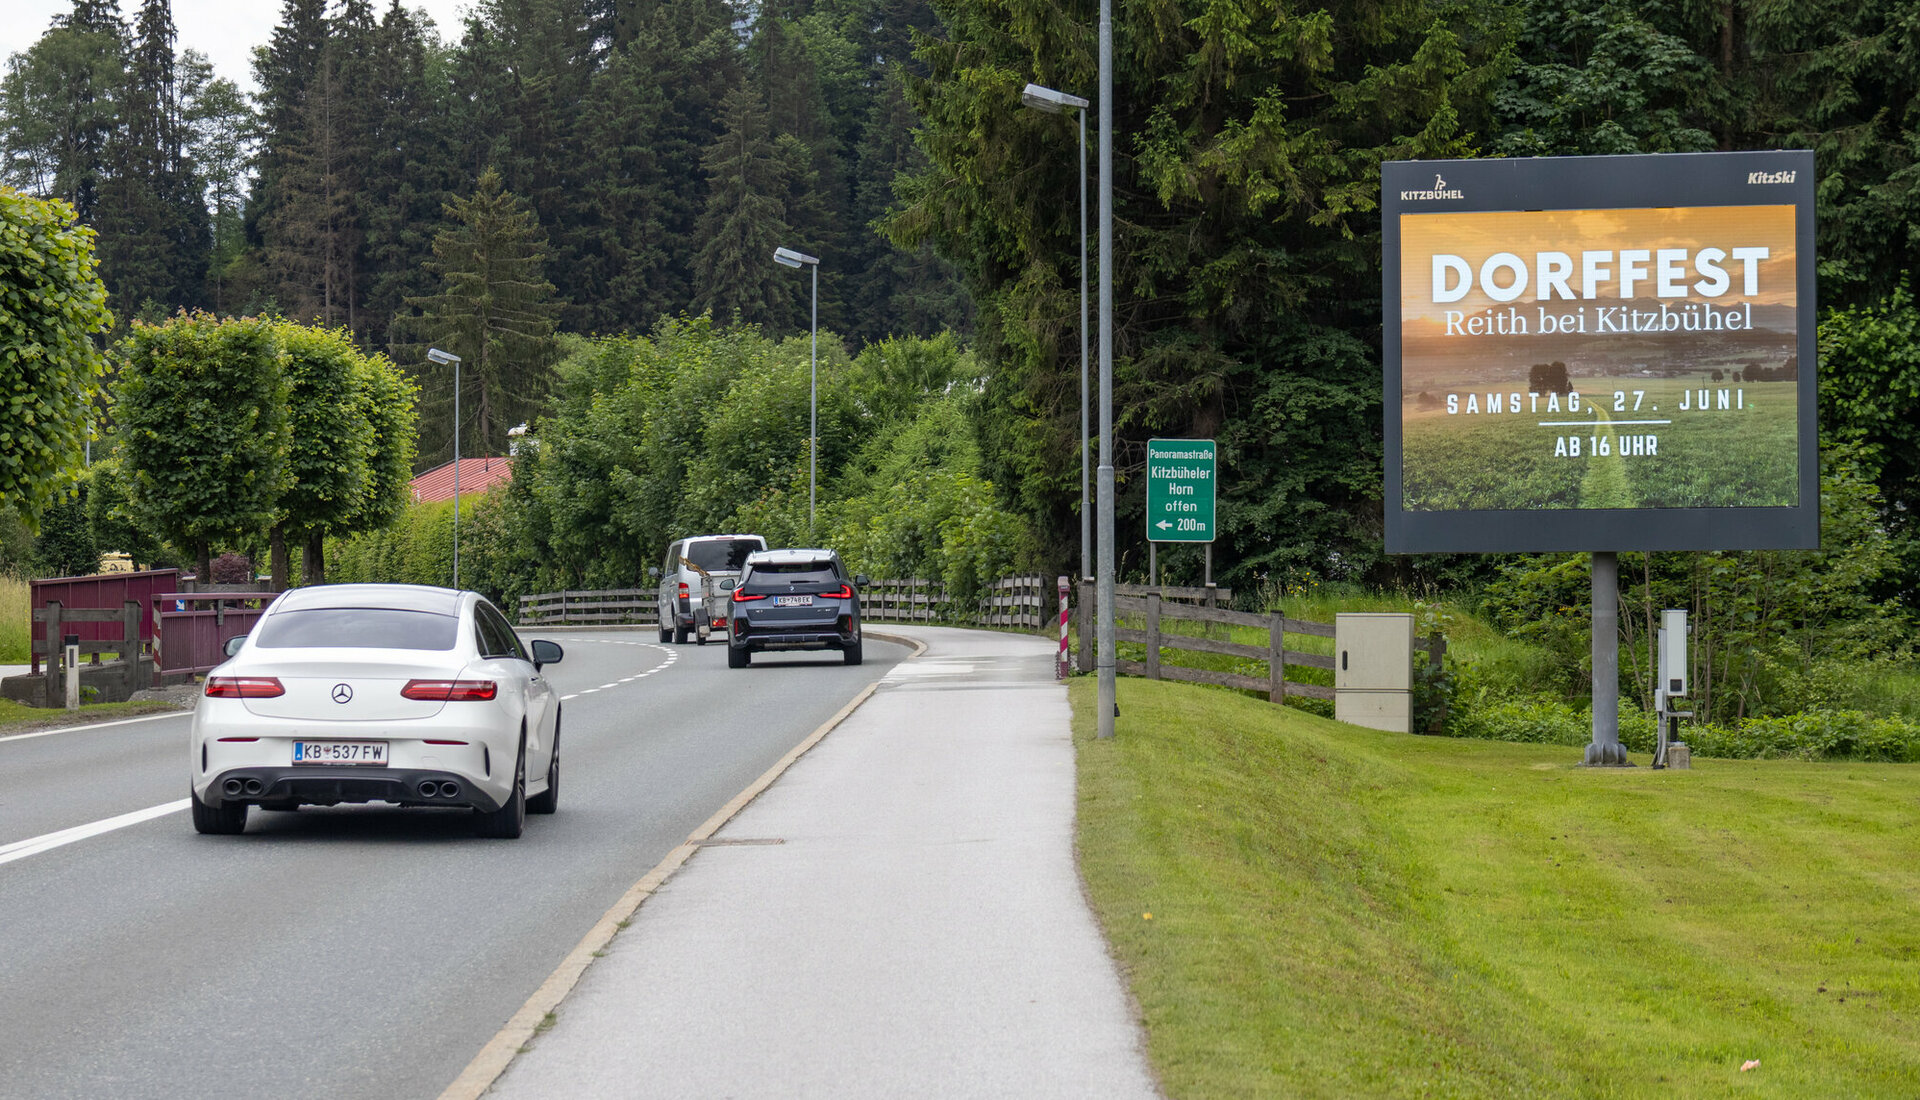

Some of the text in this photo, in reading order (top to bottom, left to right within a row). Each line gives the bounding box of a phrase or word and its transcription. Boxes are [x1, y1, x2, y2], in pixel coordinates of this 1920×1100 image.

[1748, 171, 1796, 184] KitzSki
[1432, 247, 1769, 302] DORFFEST
[1444, 303, 1753, 336] Reith bei Kitzbühel
[1447, 389, 1744, 415] SAMSTAG, 27. JUNI
[1554, 435, 1658, 457] AB 16 UHR
[1150, 449, 1213, 460] Panoramastraße
[1151, 466, 1211, 479] Kitzbüheler
[1169, 483, 1194, 495] Horn
[1165, 500, 1197, 512] offen
[304, 744, 321, 759] KB
[332, 745, 359, 759] 537
[362, 745, 383, 760] FW
